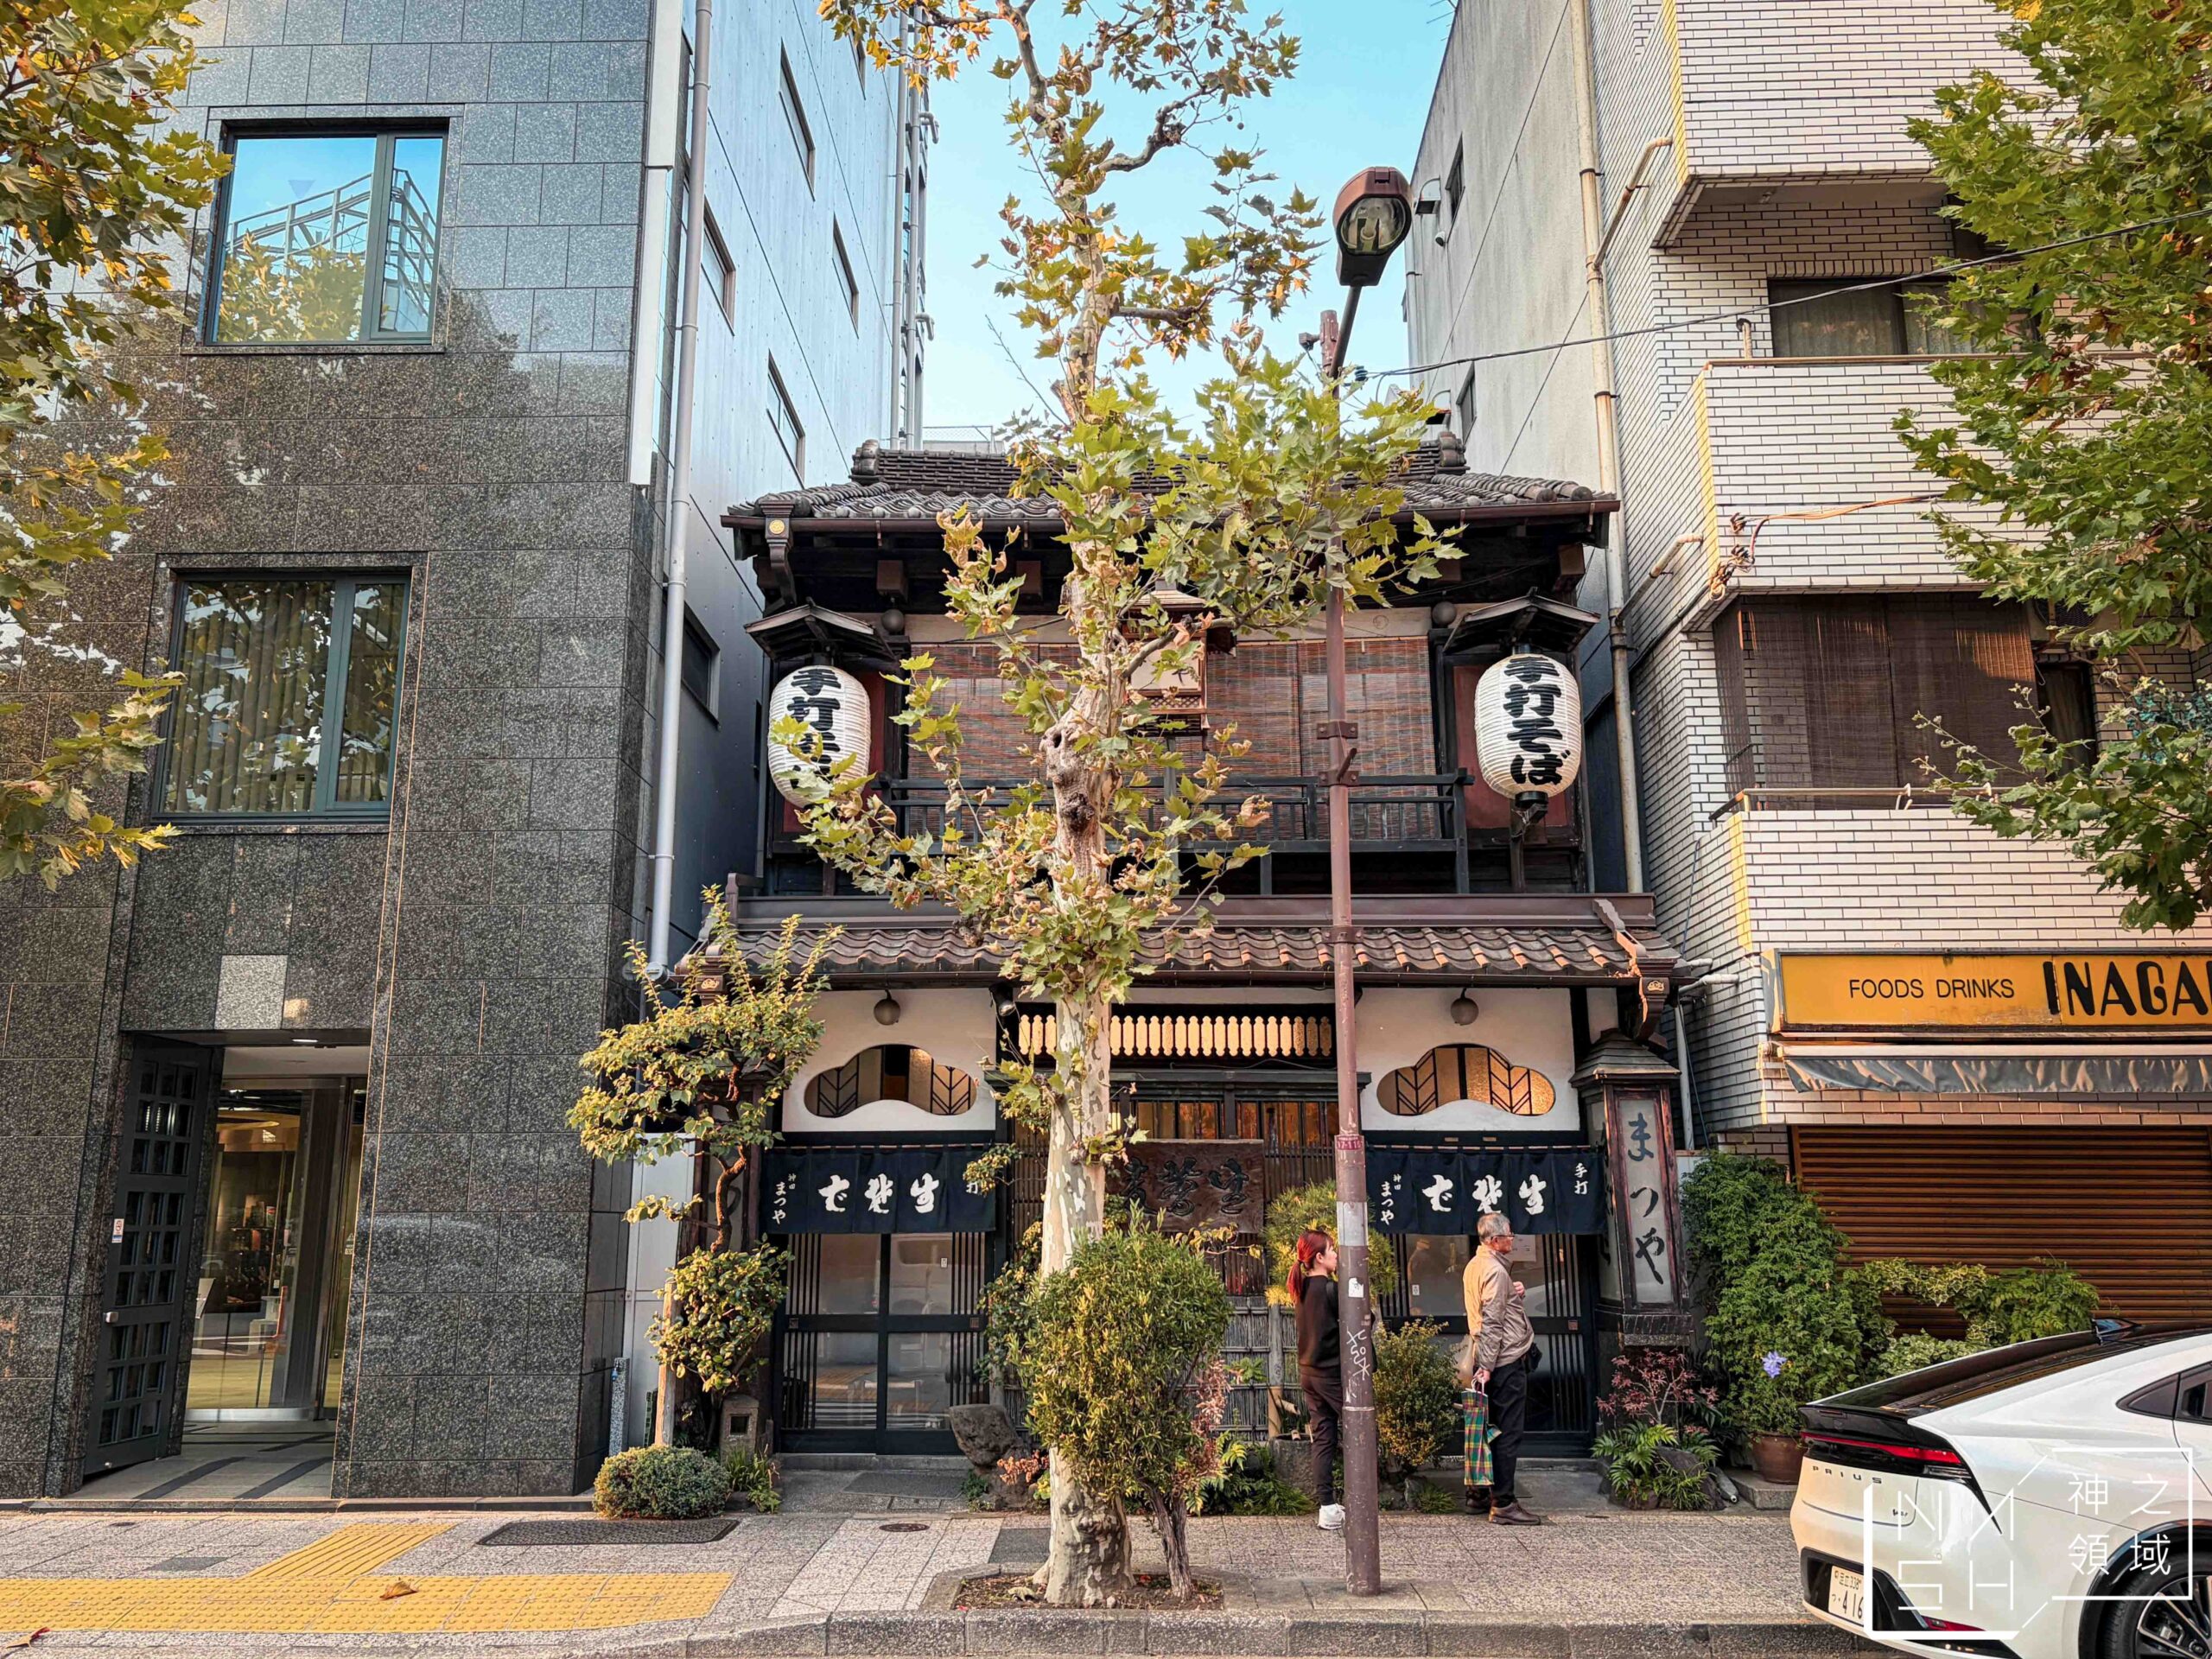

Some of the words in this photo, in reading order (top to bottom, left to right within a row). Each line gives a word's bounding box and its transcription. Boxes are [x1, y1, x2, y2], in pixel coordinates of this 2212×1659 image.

[1502, 657, 1571, 785] 手打そば
[1849, 978, 1924, 999] FOODS
[1936, 978, 2015, 999] DRINKS
[2043, 961, 2212, 1016] INAGA
[1573, 1162, 1589, 1195] 手打
[1628, 1112, 1665, 1285] まつや
[772, 1182, 786, 1224] まつや
[1380, 1181, 1395, 1225] まつや
[1812, 1465, 1882, 1484] PRIUS
